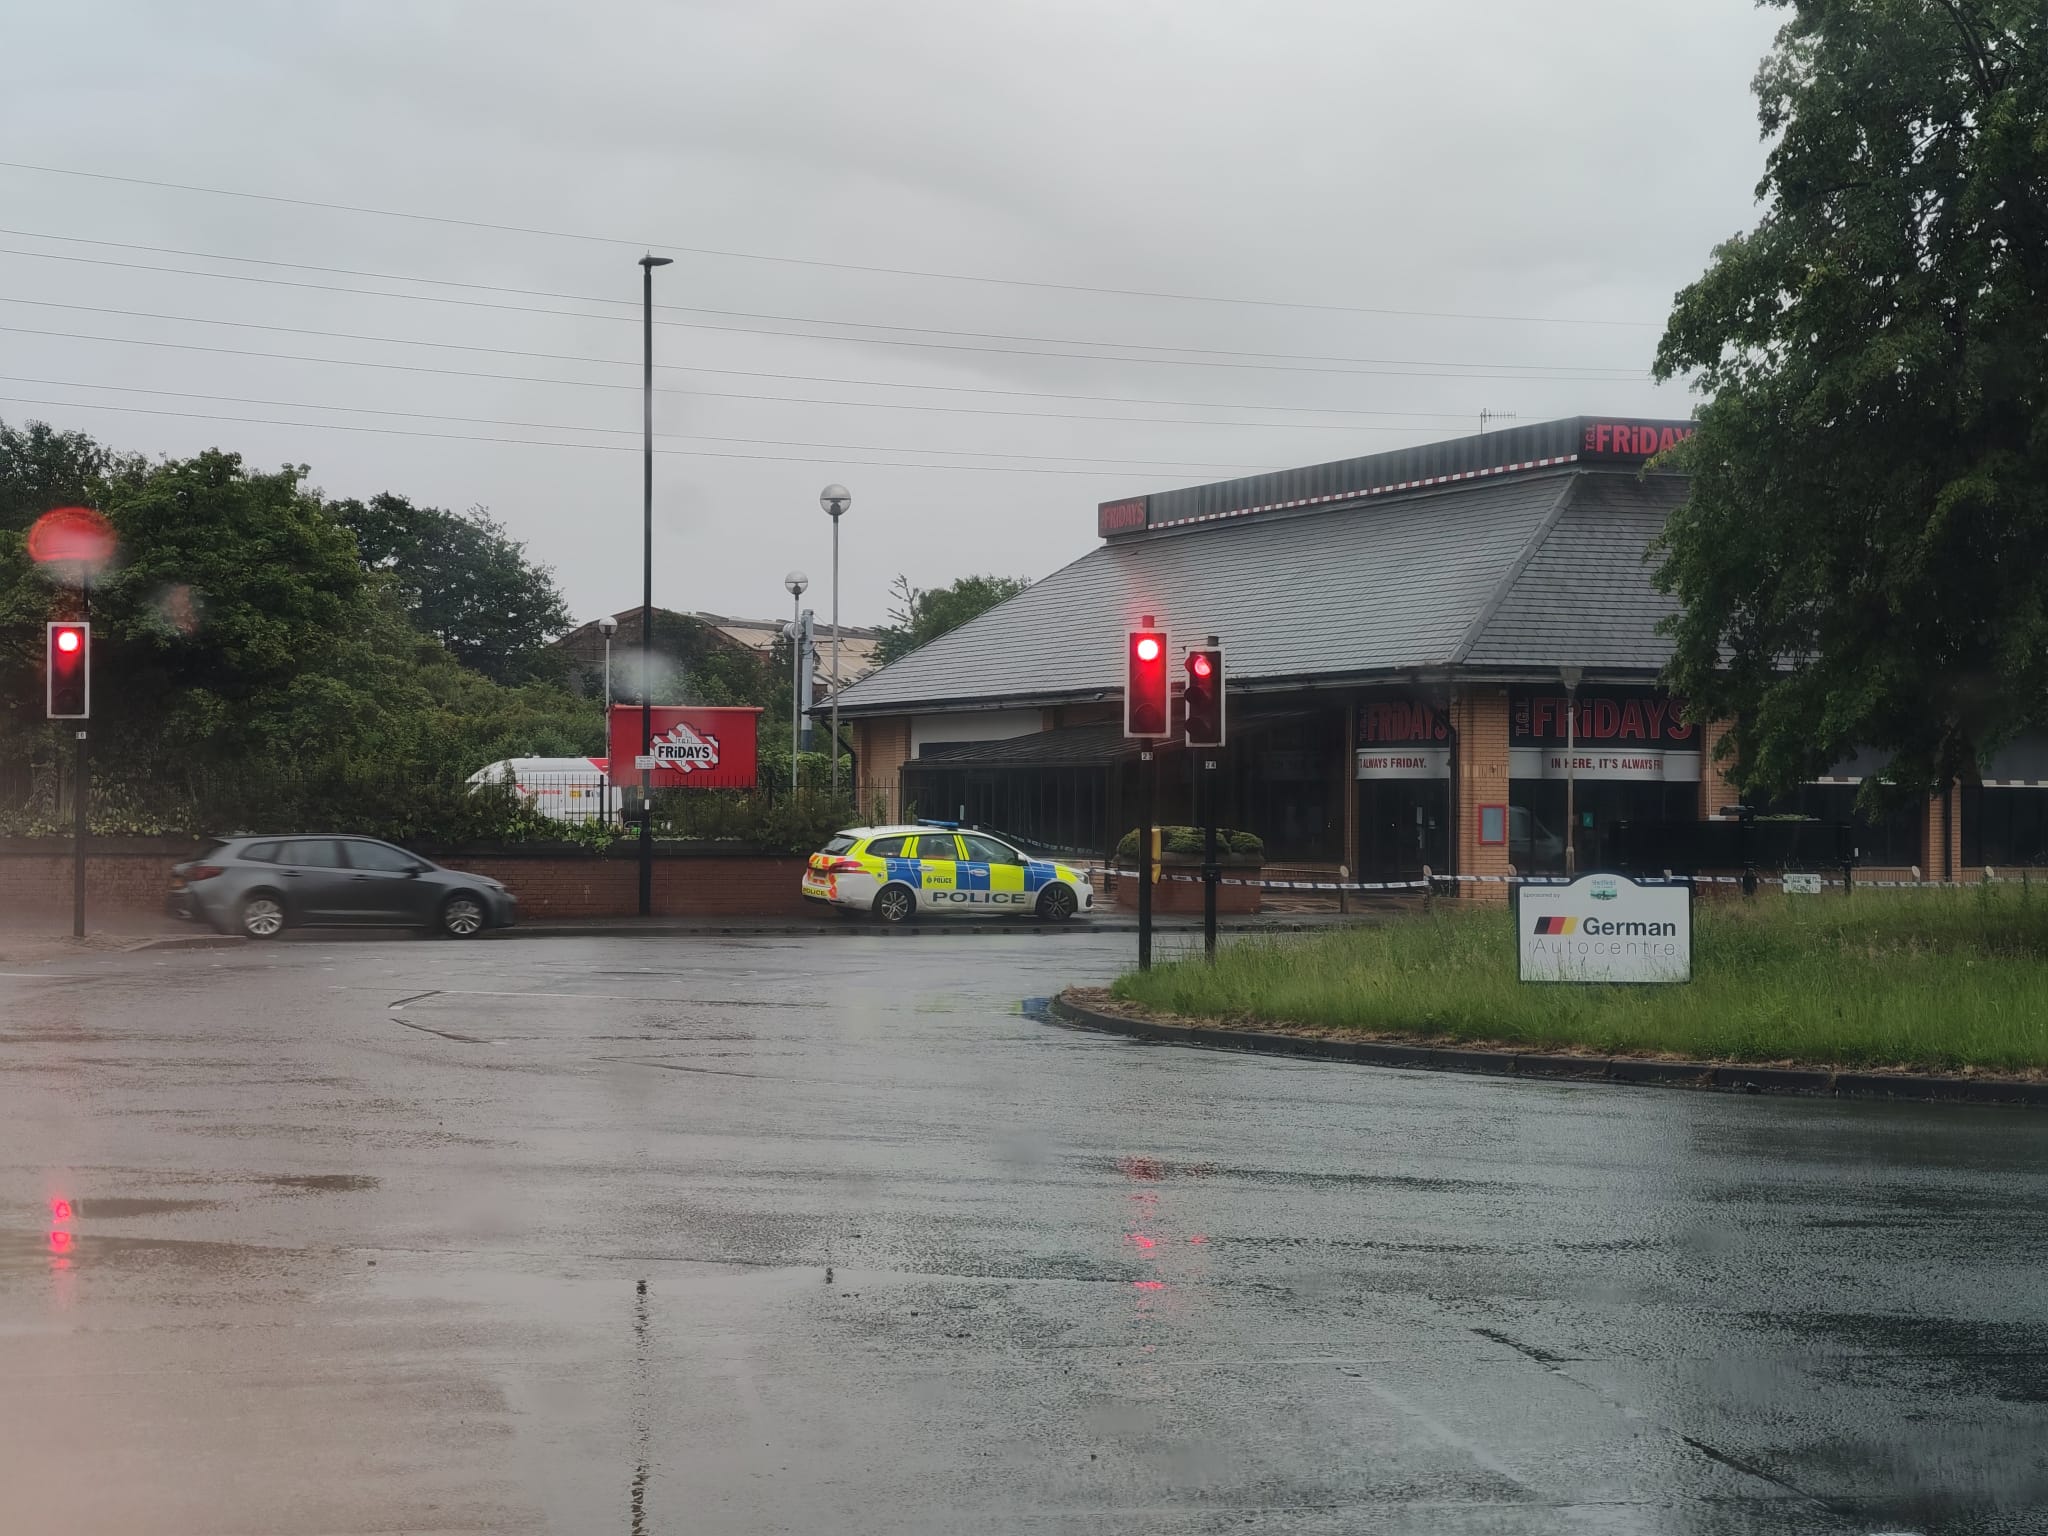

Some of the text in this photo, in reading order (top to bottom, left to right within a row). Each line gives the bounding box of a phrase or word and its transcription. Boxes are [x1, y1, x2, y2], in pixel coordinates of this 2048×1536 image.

[1390, 758, 1427, 769] FRIDAY.
[1551, 758, 1561, 769] IN
[1599, 758, 1618, 769] IT'S
[1621, 758, 1653, 770] ALWAYS
[933, 876, 952, 884] POLICE
[803, 887, 827, 896] POLICE
[932, 892, 1026, 904] POLICE
[1582, 916, 1676, 937] German
[1533, 938, 1676, 957] Autocentre
